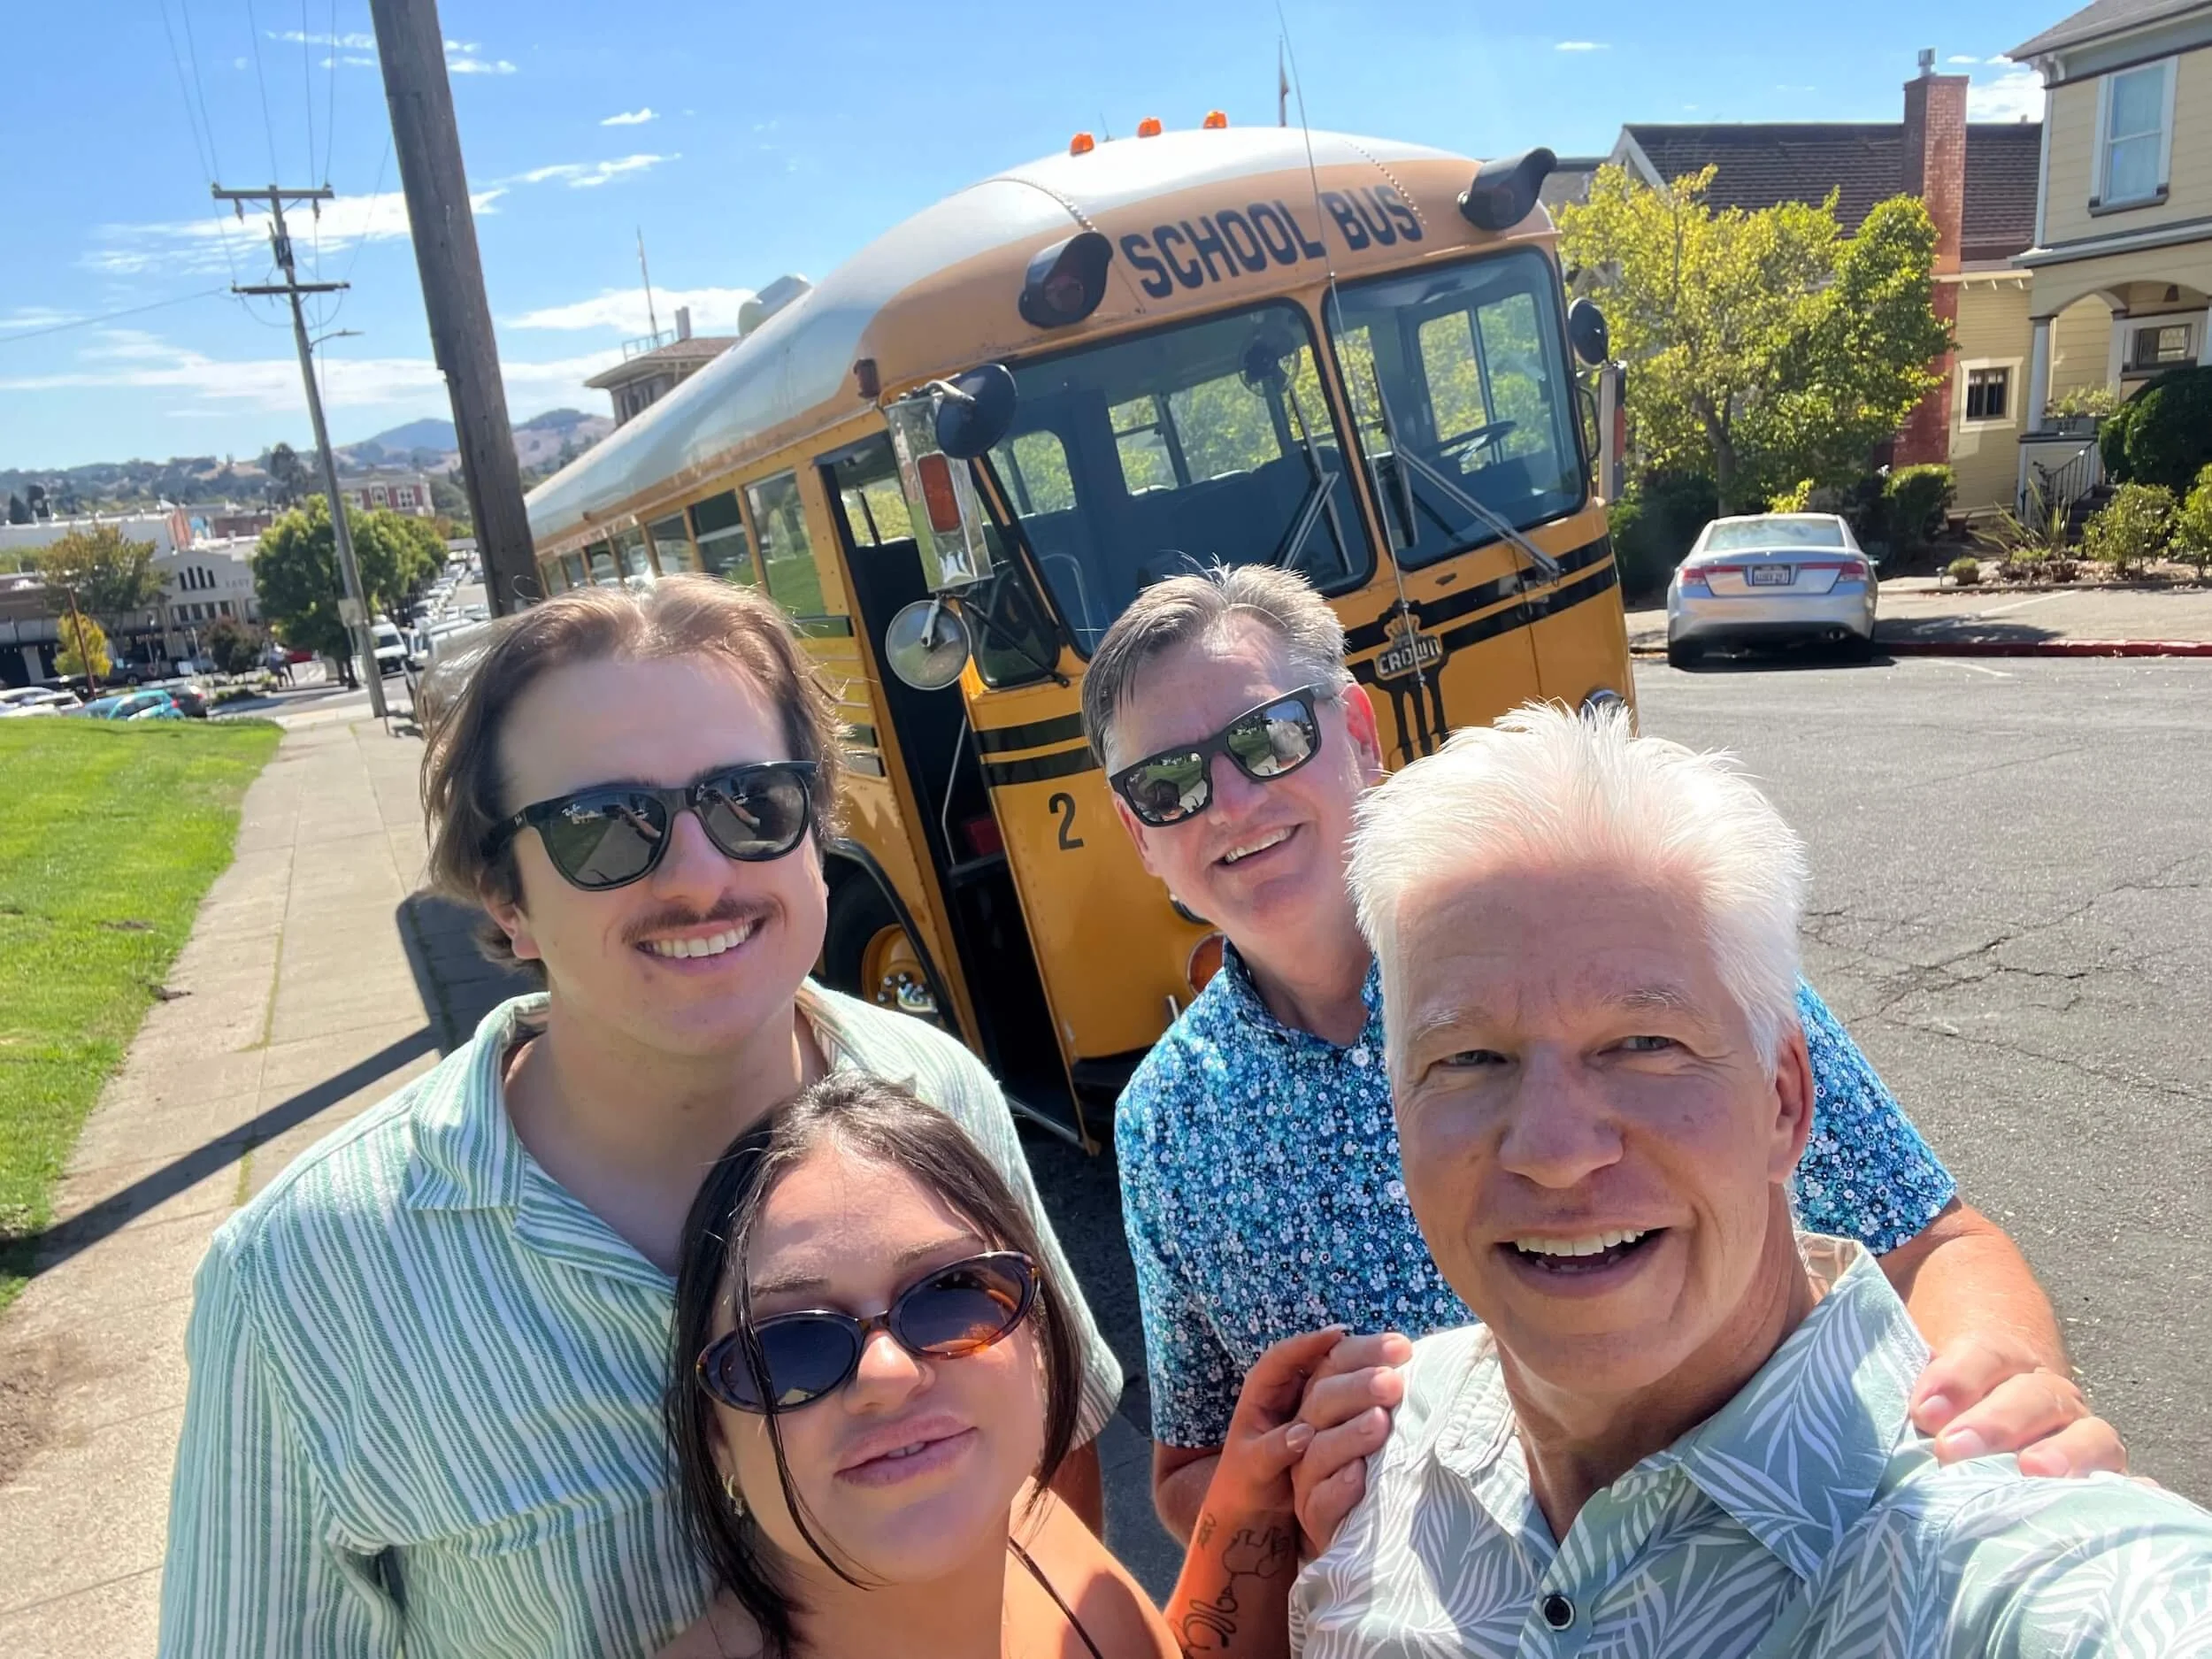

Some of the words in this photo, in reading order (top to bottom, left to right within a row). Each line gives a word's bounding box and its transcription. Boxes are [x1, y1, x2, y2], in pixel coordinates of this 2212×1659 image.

[1119, 200, 1326, 299] SCHOOL
[1319, 185, 1423, 251] BUS
[1380, 639, 1442, 674] CROWN
[1048, 792, 1084, 850] 2
